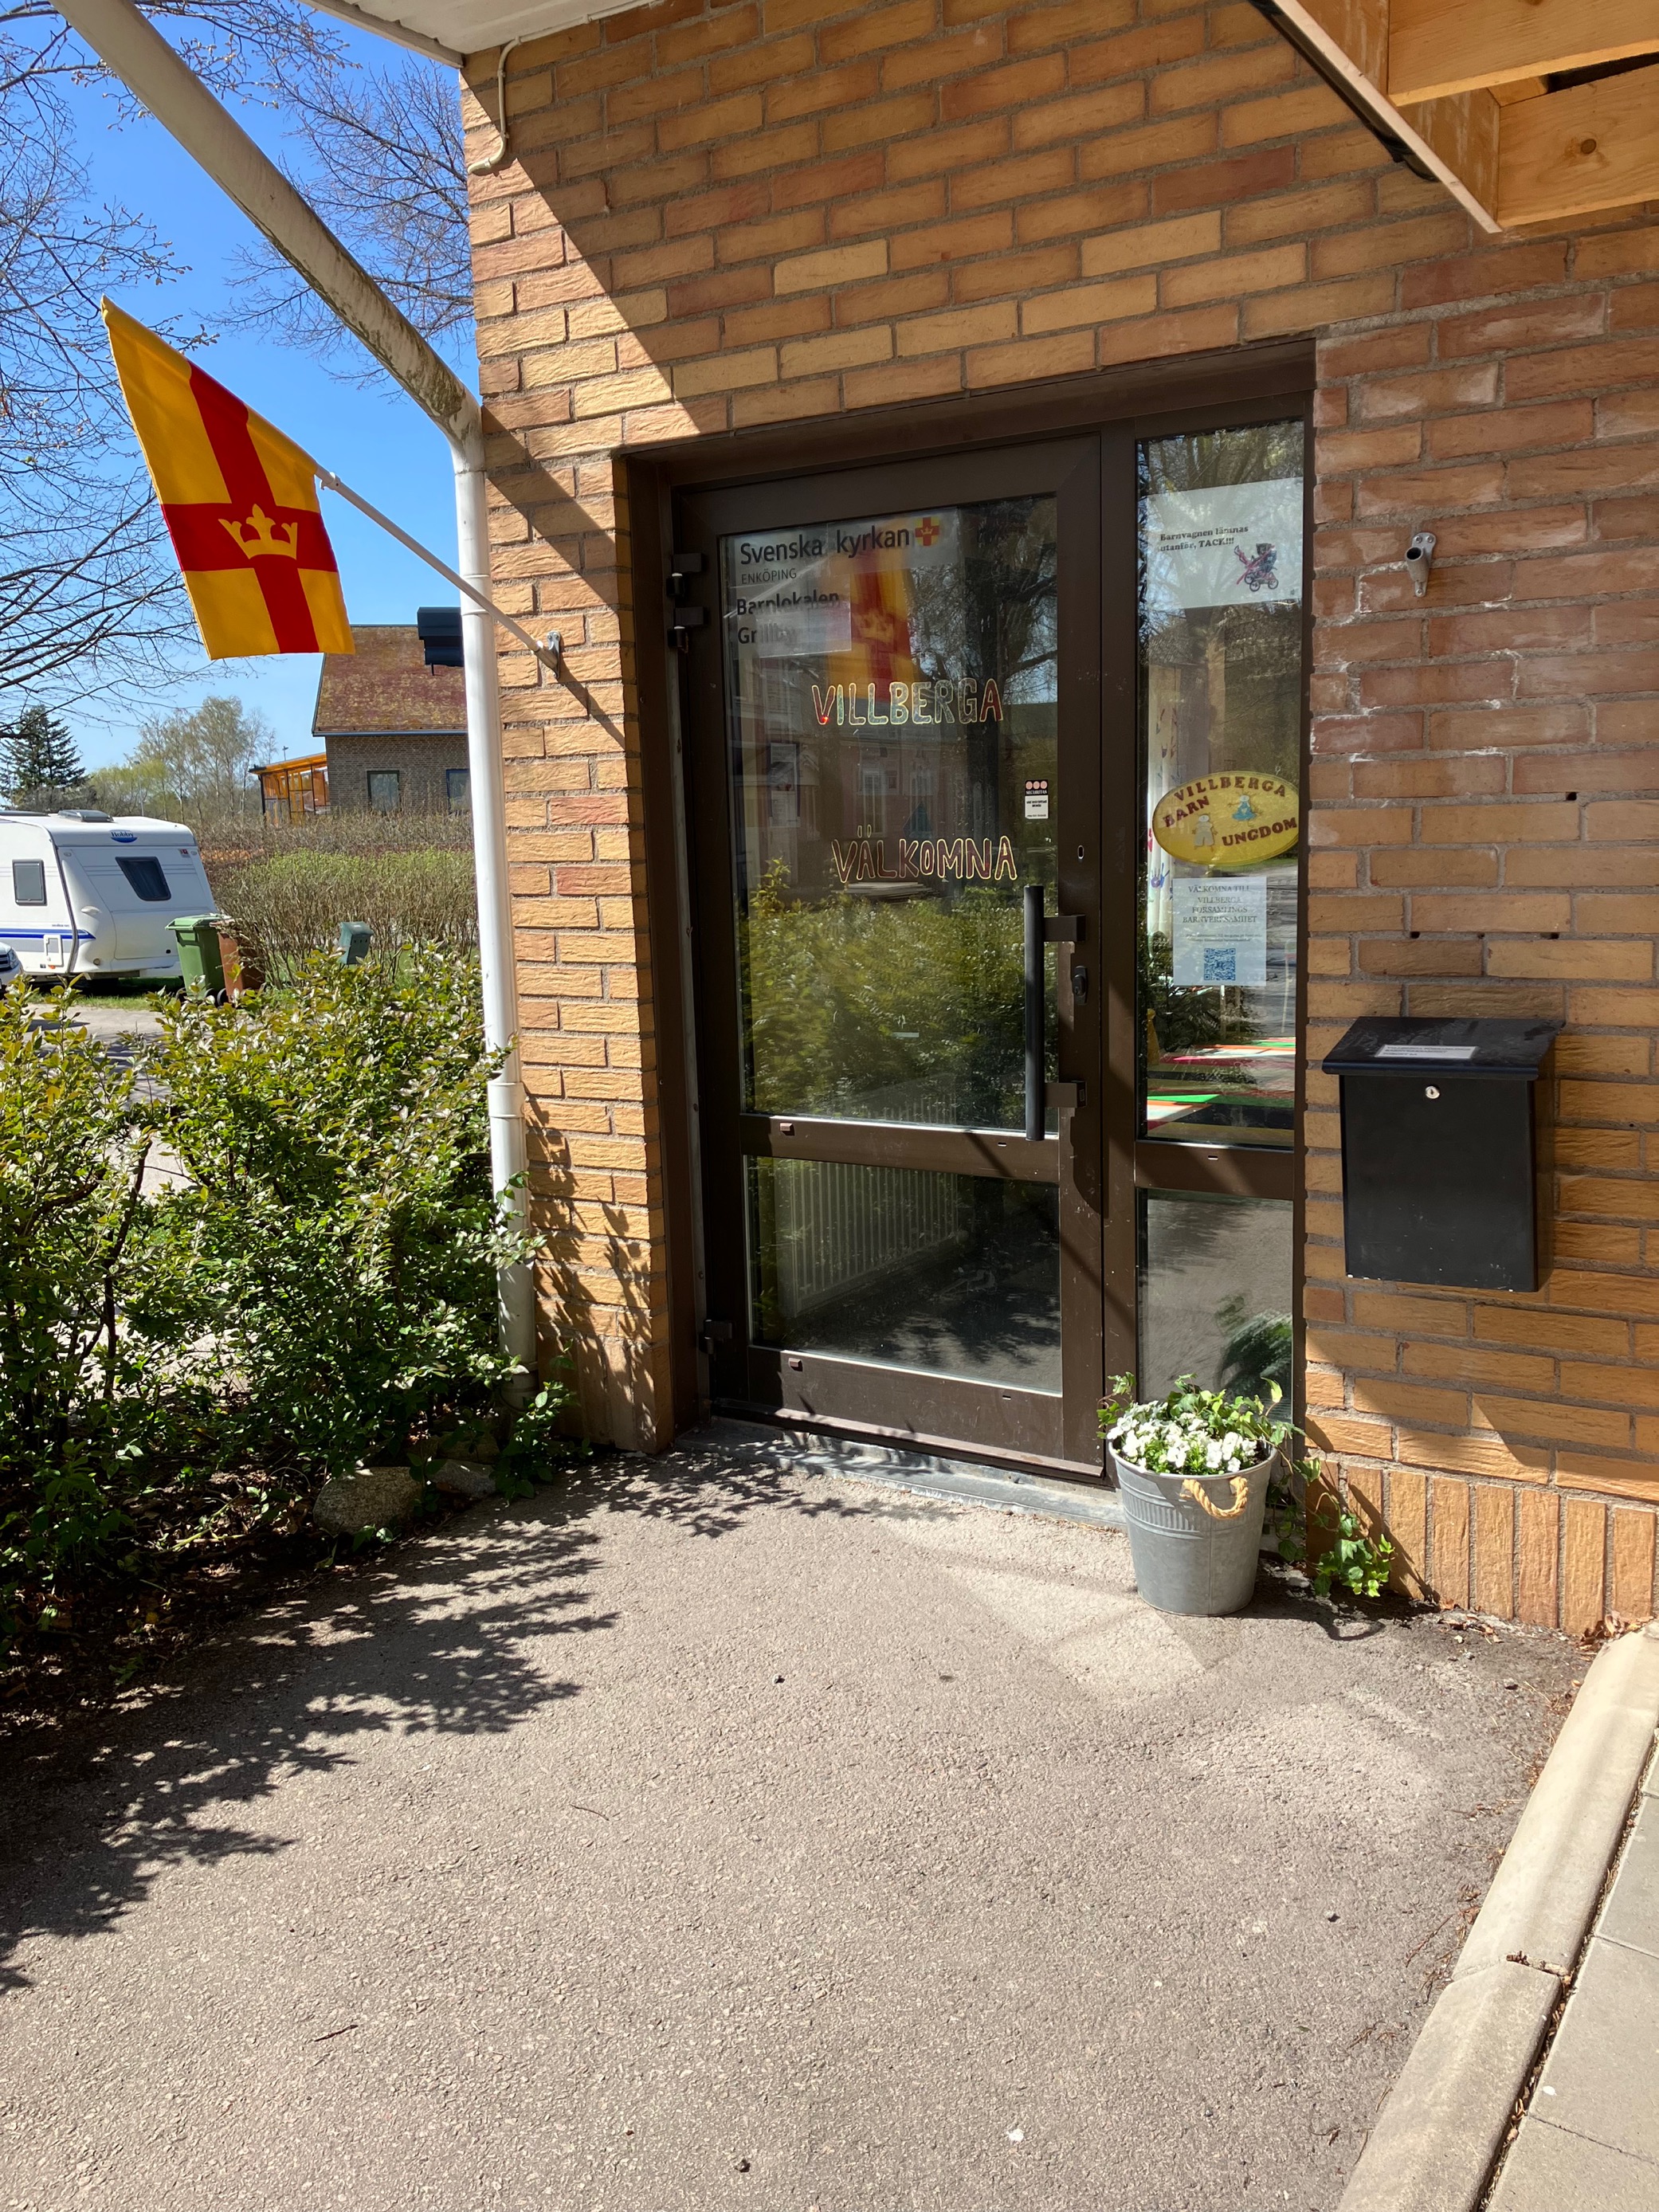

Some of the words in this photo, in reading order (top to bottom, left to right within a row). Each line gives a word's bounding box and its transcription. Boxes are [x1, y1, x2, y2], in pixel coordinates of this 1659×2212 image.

[740, 534, 823, 565] Svenska
[837, 525, 910, 559] kyrkan
[1160, 529, 1213, 541] Barnvagnen
[741, 567, 797, 585] ENKÖPING
[811, 677, 1003, 726] VILLBERGA
[1174, 775, 1287, 802] VILLBERGA
[1163, 795, 1210, 828] BARN
[1222, 817, 1297, 847] UNGDOM
[831, 824, 1018, 884] VÄLKOMNA
[1188, 884, 1233, 893] VÄLKOMNA
